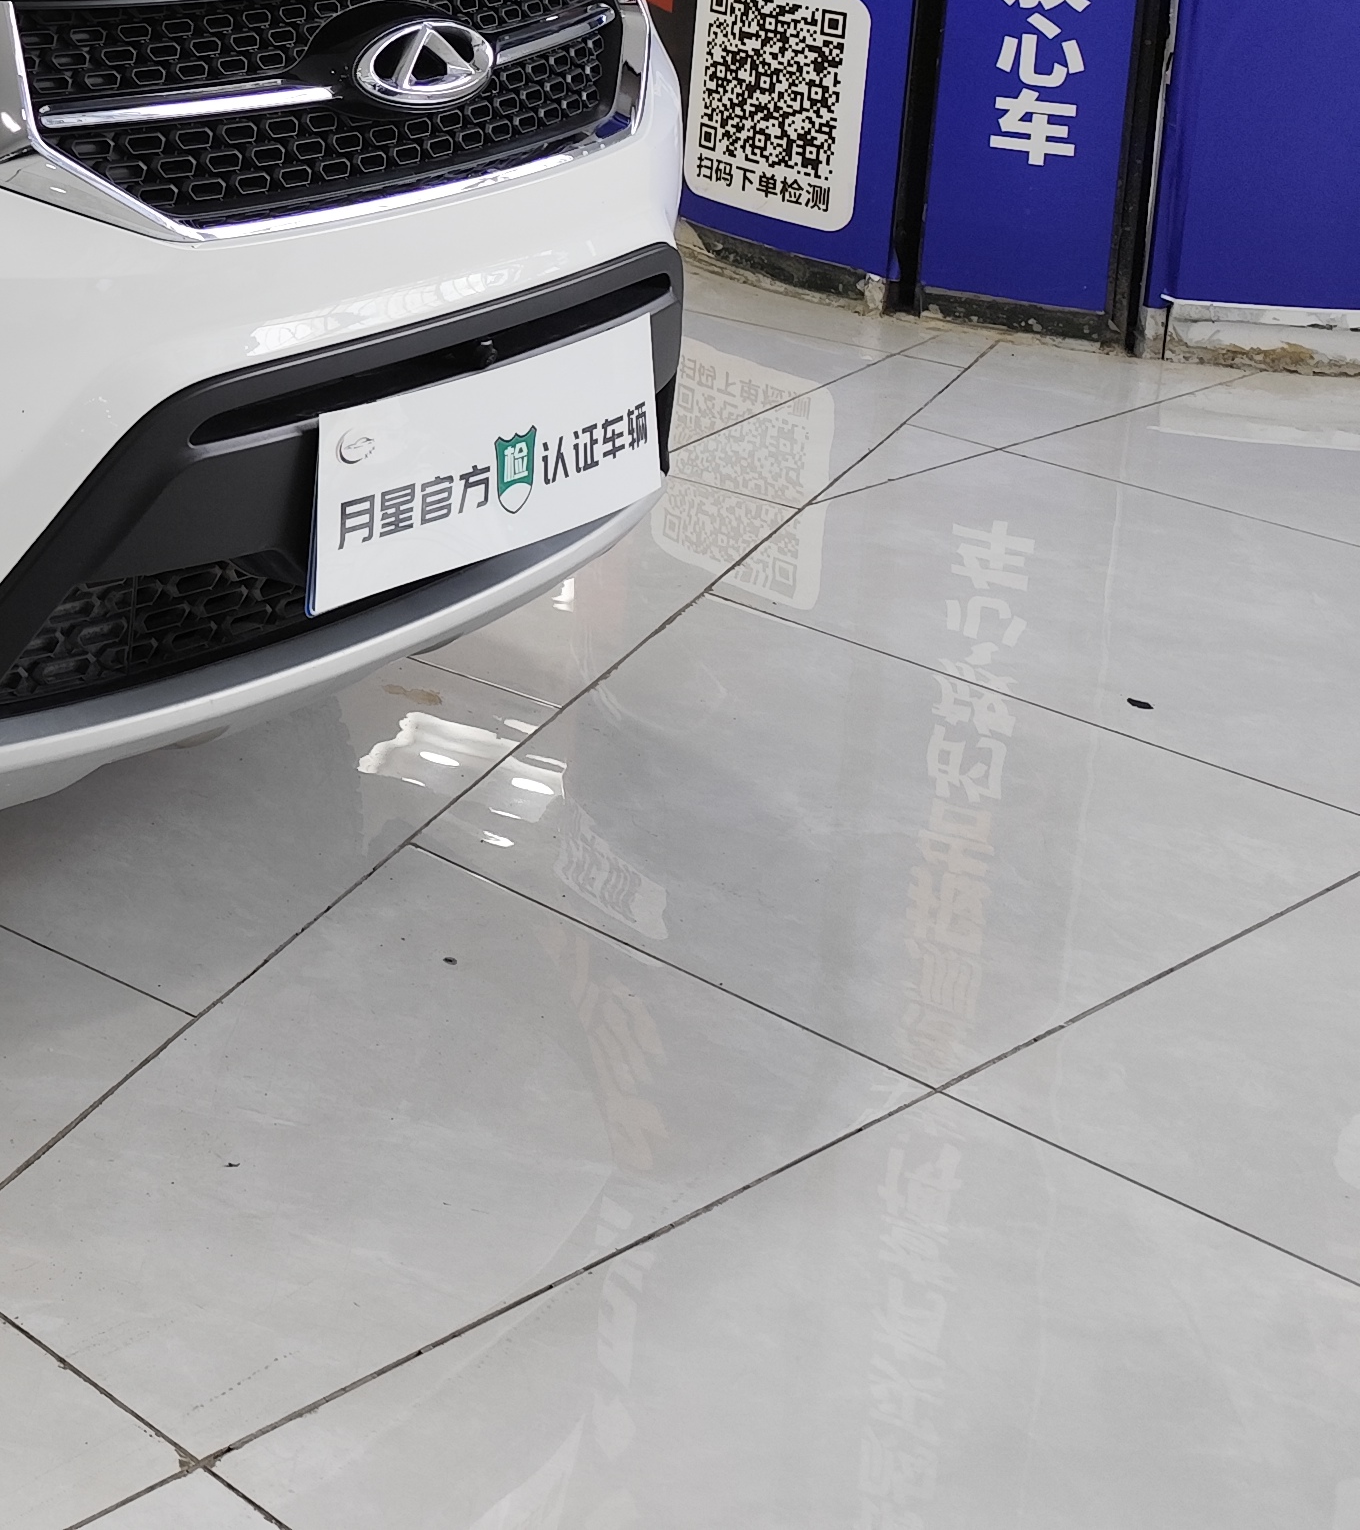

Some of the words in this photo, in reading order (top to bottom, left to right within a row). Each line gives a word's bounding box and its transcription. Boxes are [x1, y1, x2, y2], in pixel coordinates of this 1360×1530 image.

[695, 154, 832, 213] 扫码下单检测
[337, 465, 491, 551] 月星官方
[541, 400, 649, 486] 认证车辆
